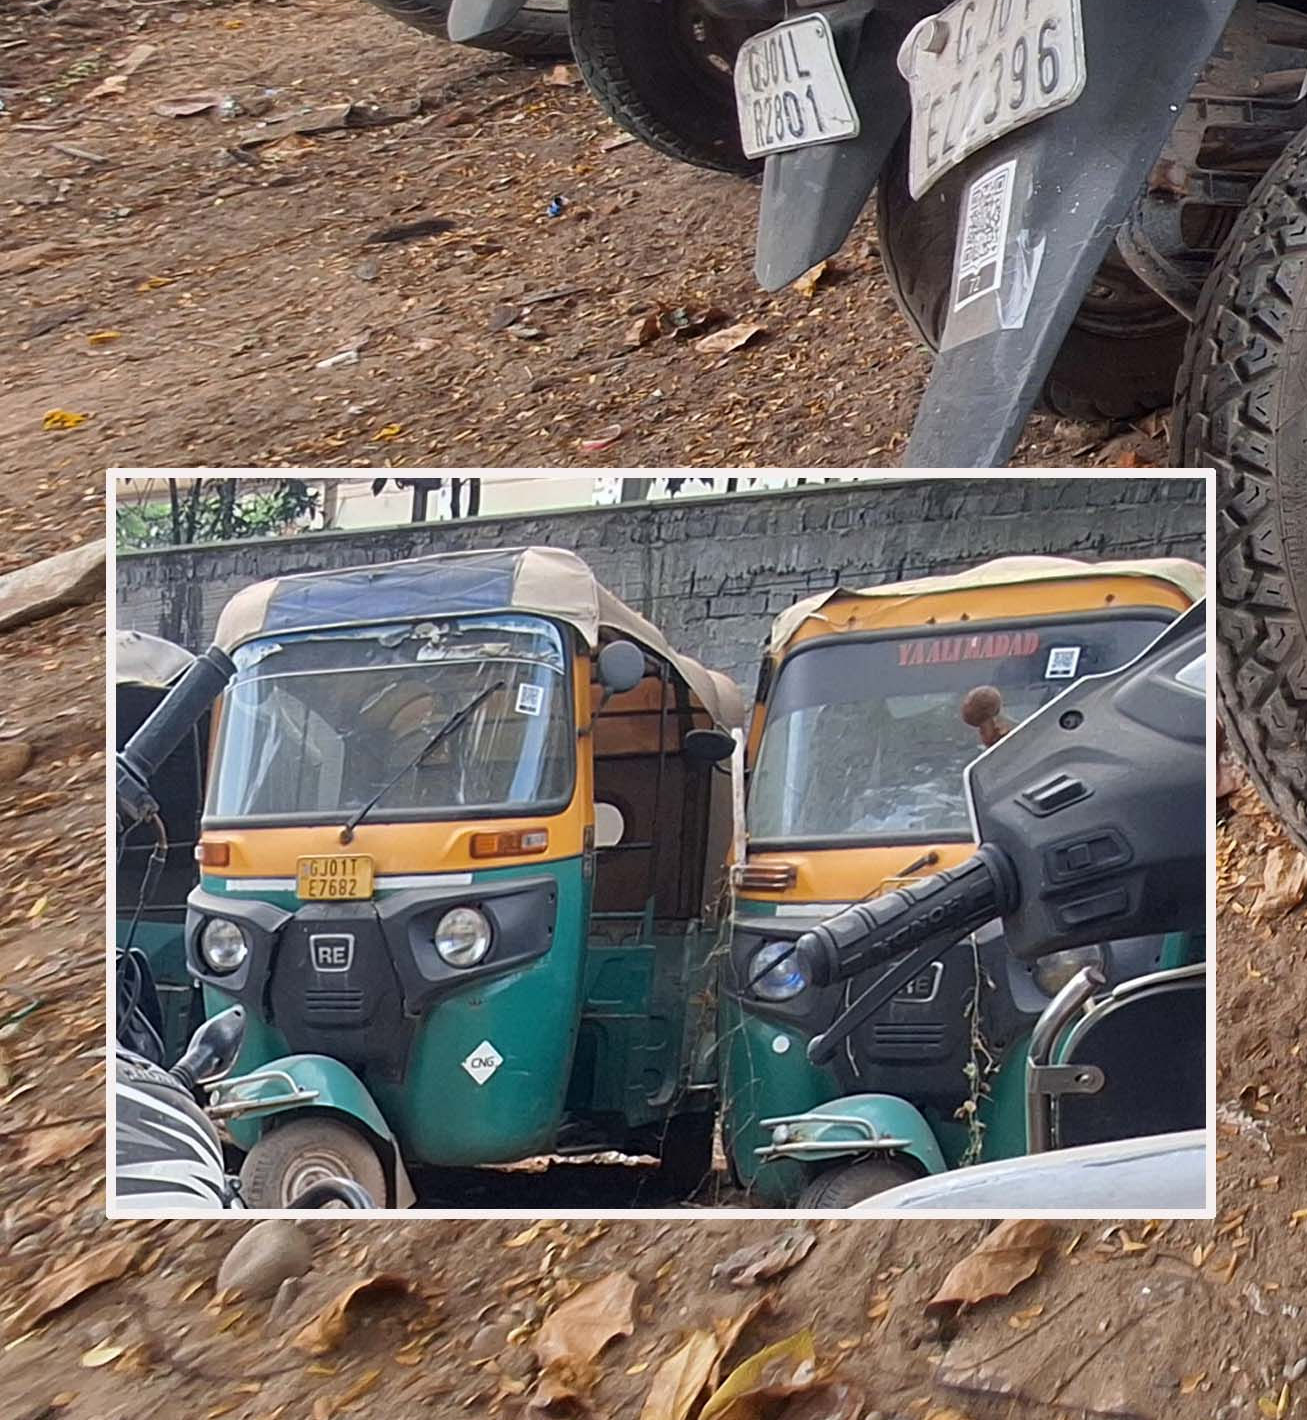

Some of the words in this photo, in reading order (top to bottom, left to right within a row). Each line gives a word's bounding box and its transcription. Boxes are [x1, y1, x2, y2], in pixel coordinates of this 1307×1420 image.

[748, 30, 811, 94] GJ01L
[753, 83, 824, 149] R2801
[310, 859, 358, 877] GJ01T
[308, 878, 357, 897] E7682
[318, 946, 346, 964] RE
[471, 1056, 495, 1069] CNG
